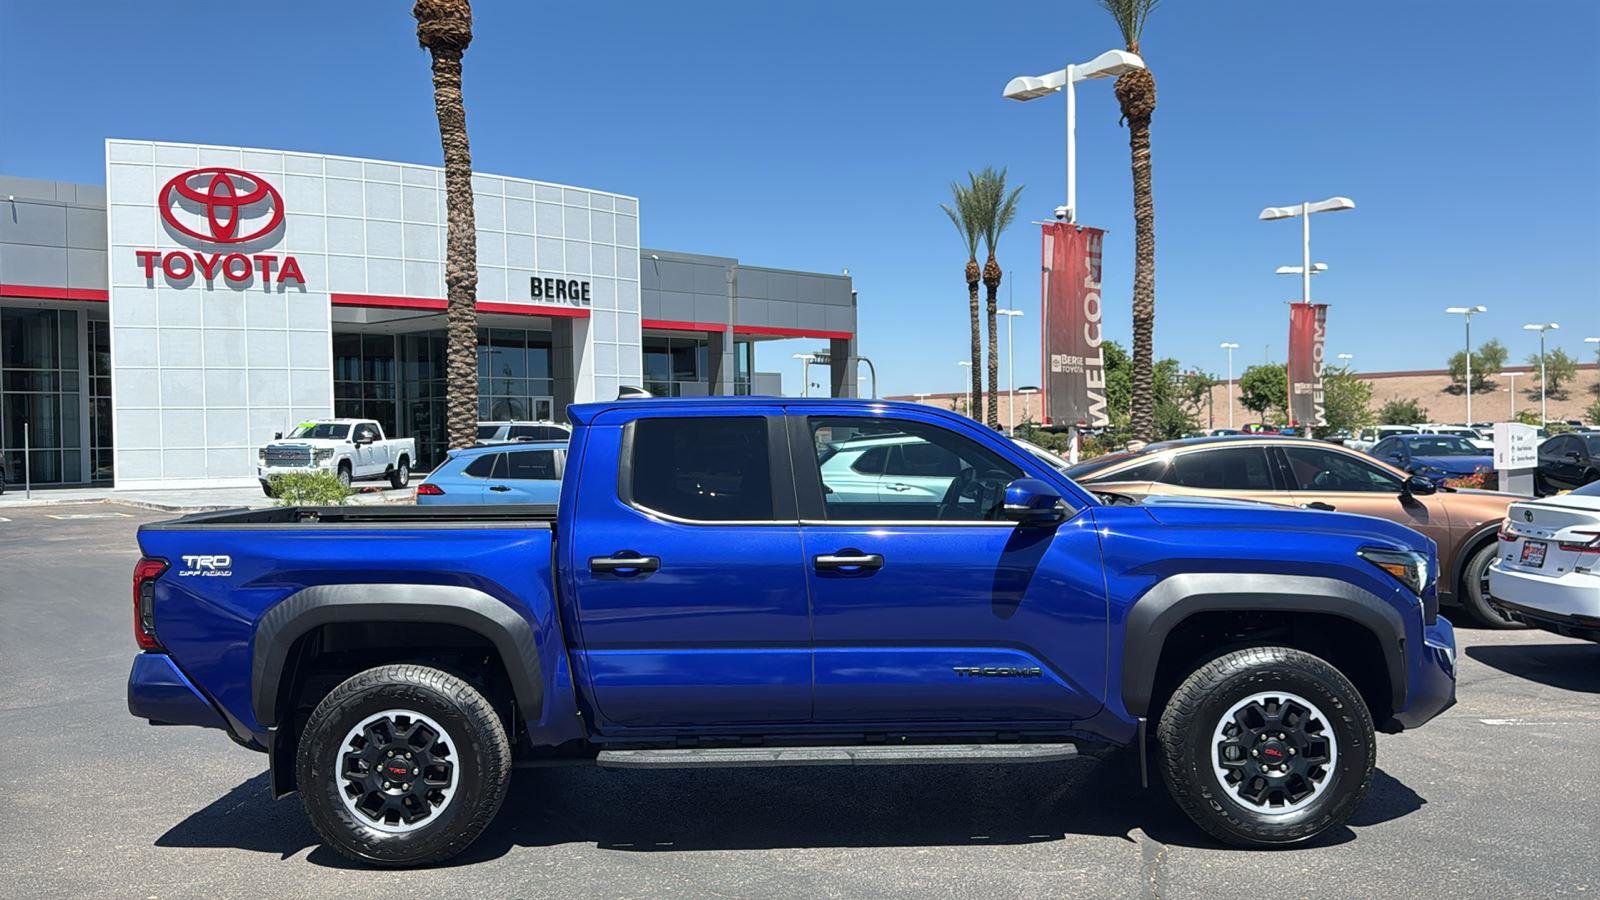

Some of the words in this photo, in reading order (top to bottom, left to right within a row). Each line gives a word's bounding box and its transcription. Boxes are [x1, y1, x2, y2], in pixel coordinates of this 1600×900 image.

[135, 250, 306, 284] TOYOTA
[530, 276, 591, 302] BERGE
[1084, 233, 1109, 427] WELCOME
[1061, 365, 1084, 374] TOYOTA
[1313, 306, 1328, 427] WELCOME
[181, 555, 231, 570] TRD
[952, 666, 1043, 677] TACOMA
